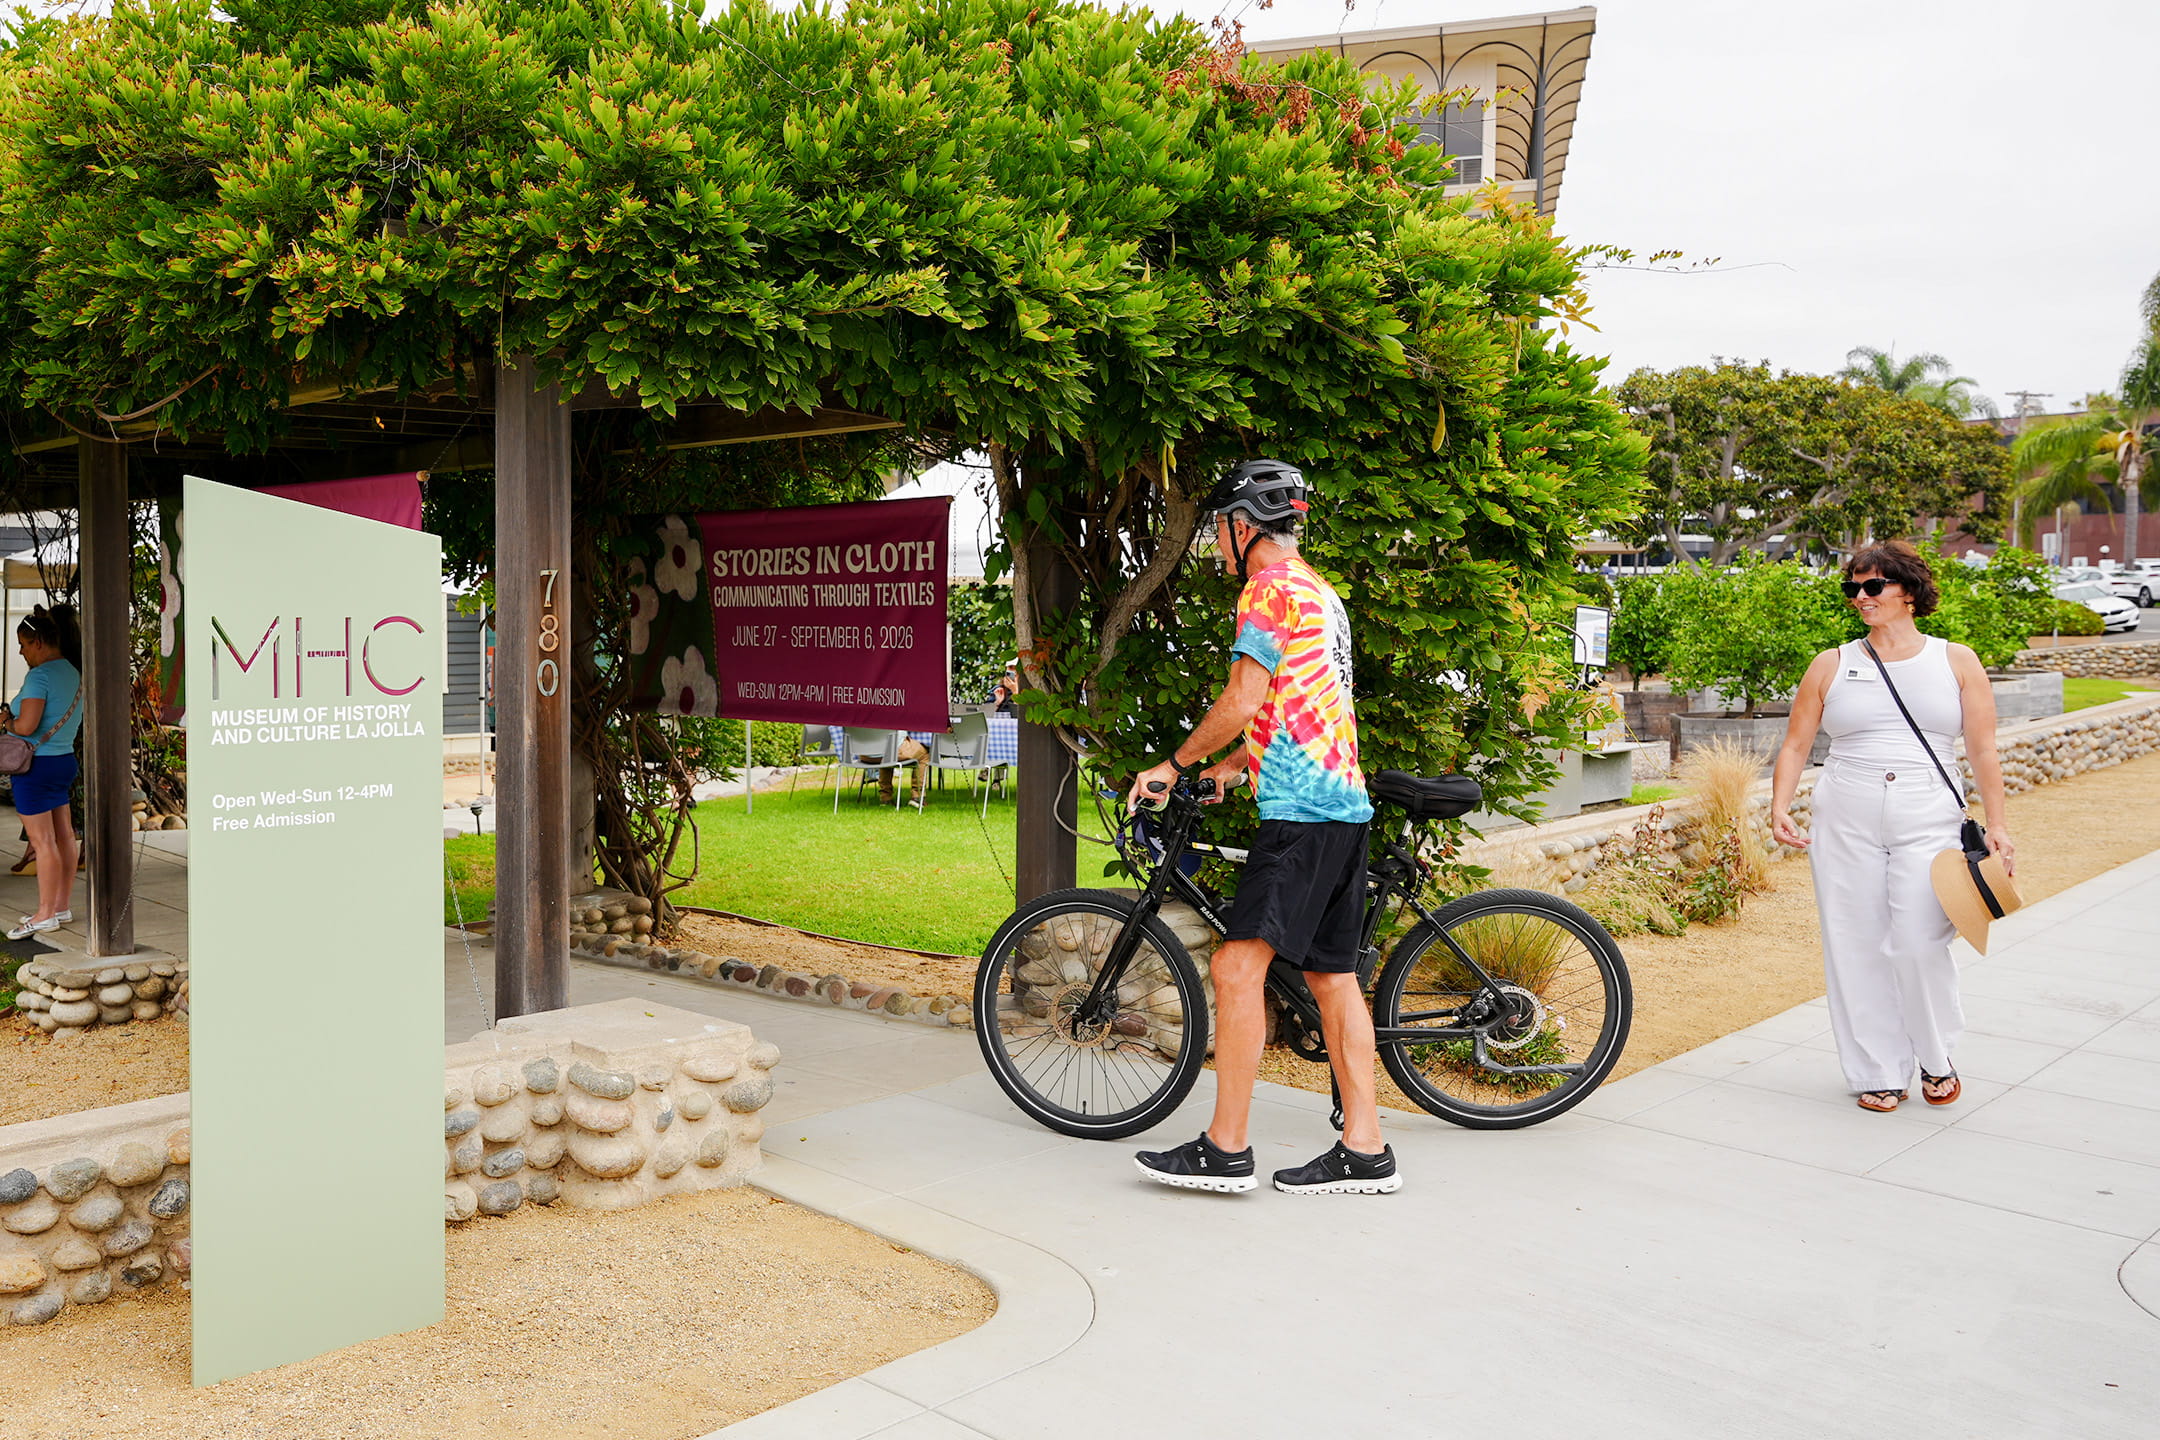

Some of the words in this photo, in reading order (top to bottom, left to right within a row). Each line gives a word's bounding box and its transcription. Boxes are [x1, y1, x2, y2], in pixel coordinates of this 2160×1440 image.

[713, 547, 811, 577] STORIES
[816, 546, 840, 574] IN
[845, 541, 935, 573] CLOTH
[714, 584, 809, 608] COMMUNICATING
[812, 584, 870, 606] THROUGH
[875, 581, 935, 606] TEXTILES
[537, 569, 559, 696] 780
[732, 625, 759, 647] JUNE
[764, 625, 777, 647] 27
[791, 626, 860, 649] SEPTEMBER
[864, 626, 876, 651] 6,
[880, 626, 913, 649] 2026
[211, 615, 425, 700] MHC
[737, 681, 776, 700] WED-SUN
[778, 684, 824, 702] 12PM-4PM
[832, 686, 854, 704] FREE
[857, 688, 905, 706] ADMISSION
[211, 707, 299, 727] MUSEUM
[303, 706, 328, 723] OF
[334, 703, 412, 722] HISTORY
[211, 728, 251, 746] AND
[256, 724, 341, 744] CULTURE
[345, 723, 368, 740] LA
[371, 720, 425, 739] JOLLA
[212, 793, 256, 811] Open
[260, 788, 332, 806] Wed-Sun
[336, 783, 394, 801] 12-4PM
[212, 816, 249, 832] Free
[253, 811, 336, 829] Admission
[1200, 906, 1214, 920] RAD
